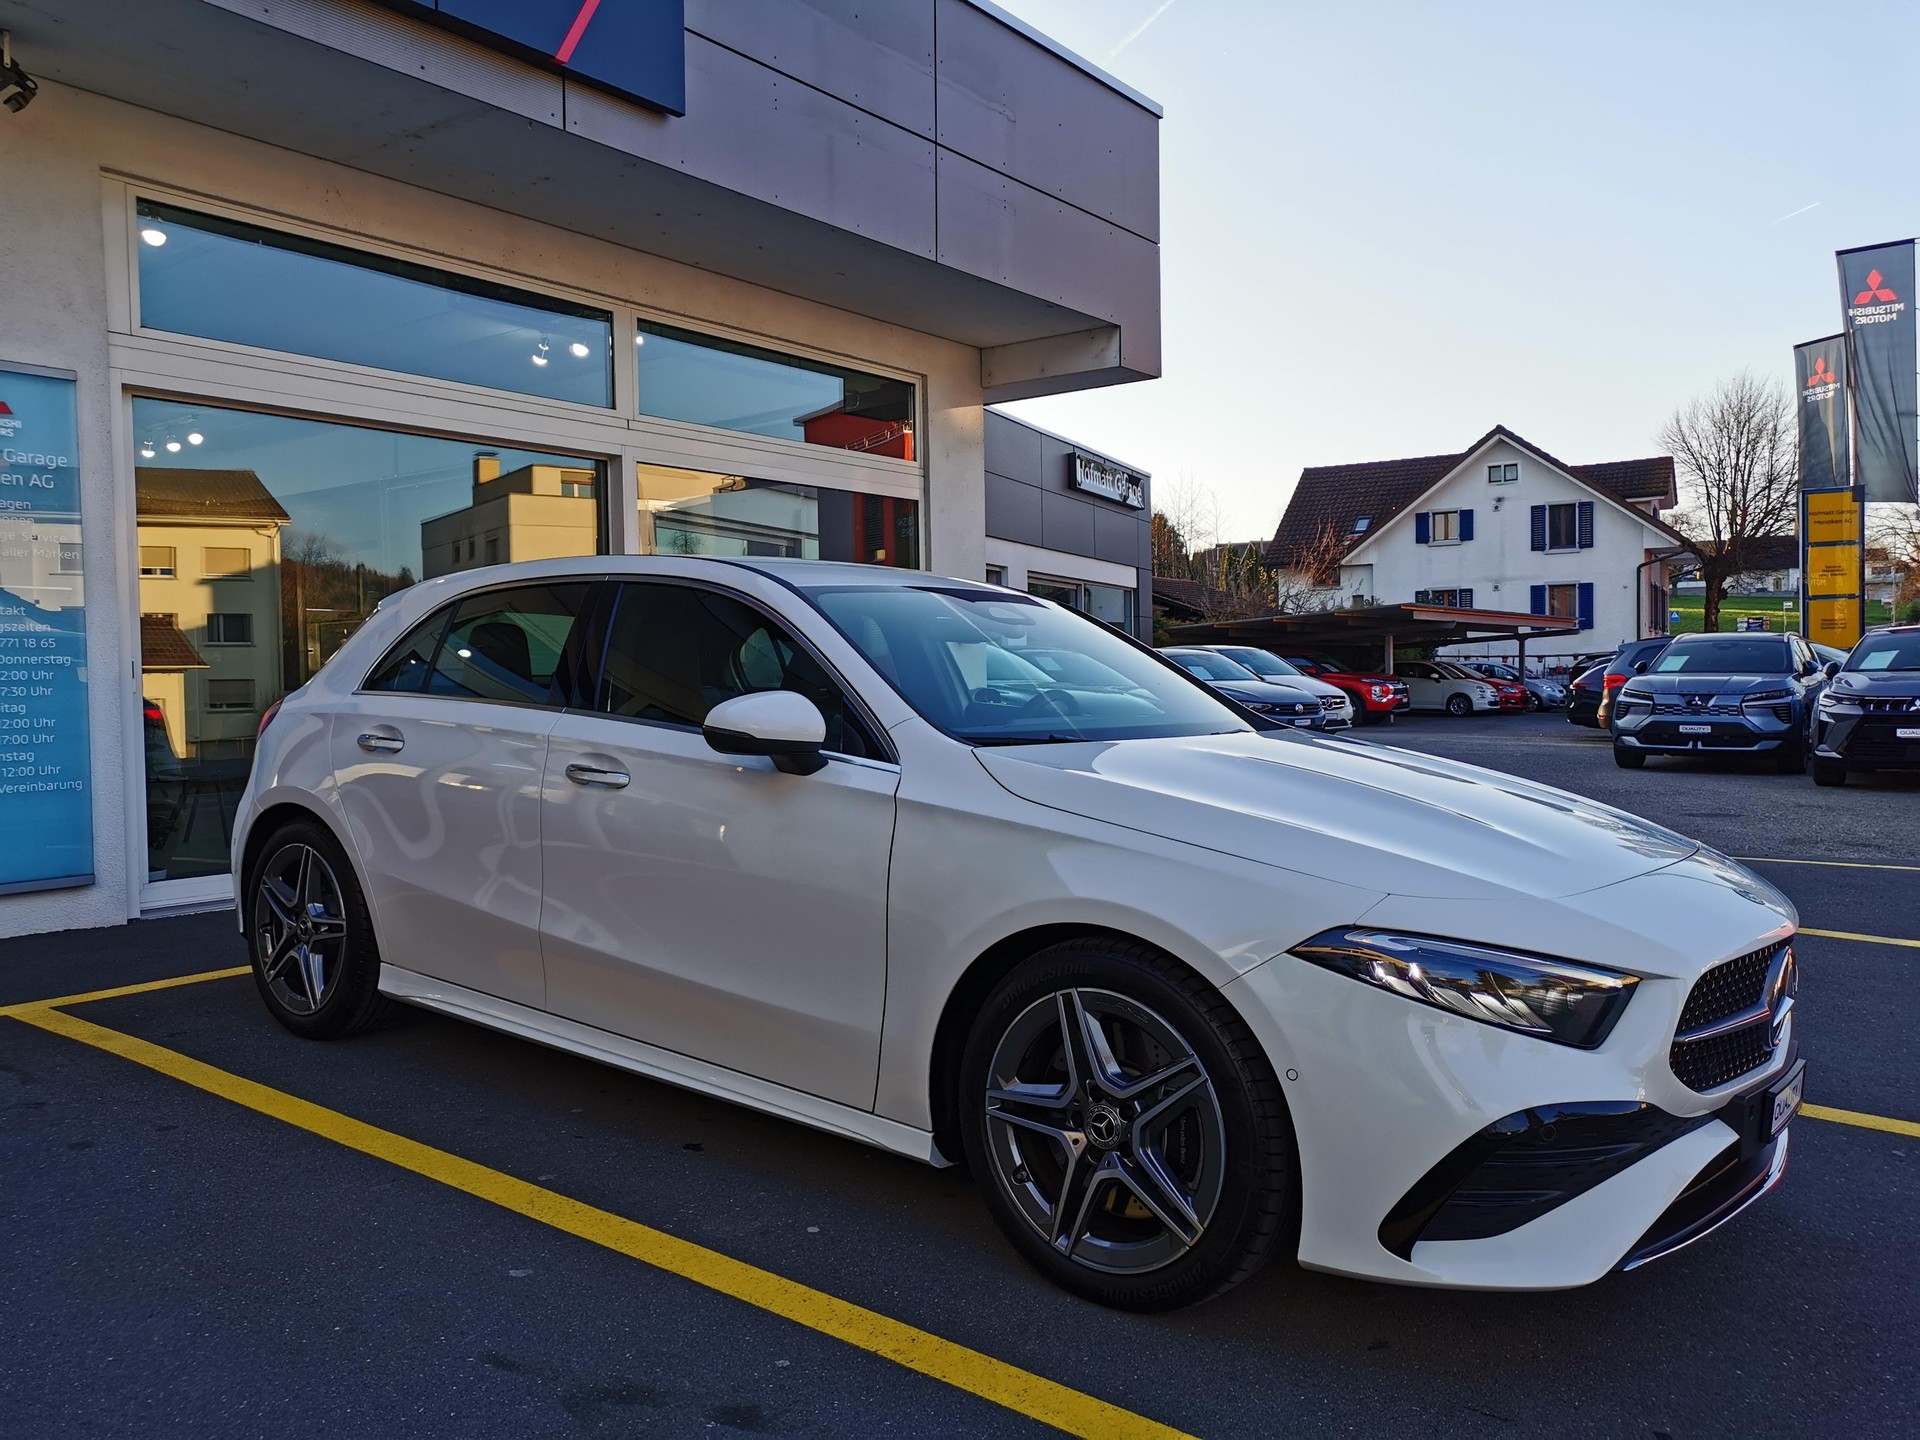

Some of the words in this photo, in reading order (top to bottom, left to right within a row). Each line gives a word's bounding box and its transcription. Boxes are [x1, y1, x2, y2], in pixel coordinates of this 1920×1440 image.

[3, 448, 67, 469] Garage
[29, 474, 54, 488] AG
[1076, 458, 1113, 492] Hofmatt
[21, 530, 67, 543] Service
[2, 547, 28, 557] aller
[33, 548, 79, 560] Marken
[23, 638, 36, 648] 18
[41, 638, 56, 648] 65
[32, 670, 54, 680] Uhr
[31, 686, 53, 696] Uhr
[34, 718, 56, 728] Uhr
[33, 734, 55, 744] Uhr
[2, 767, 35, 777] 12:00
[39, 765, 61, 775] Uhr
